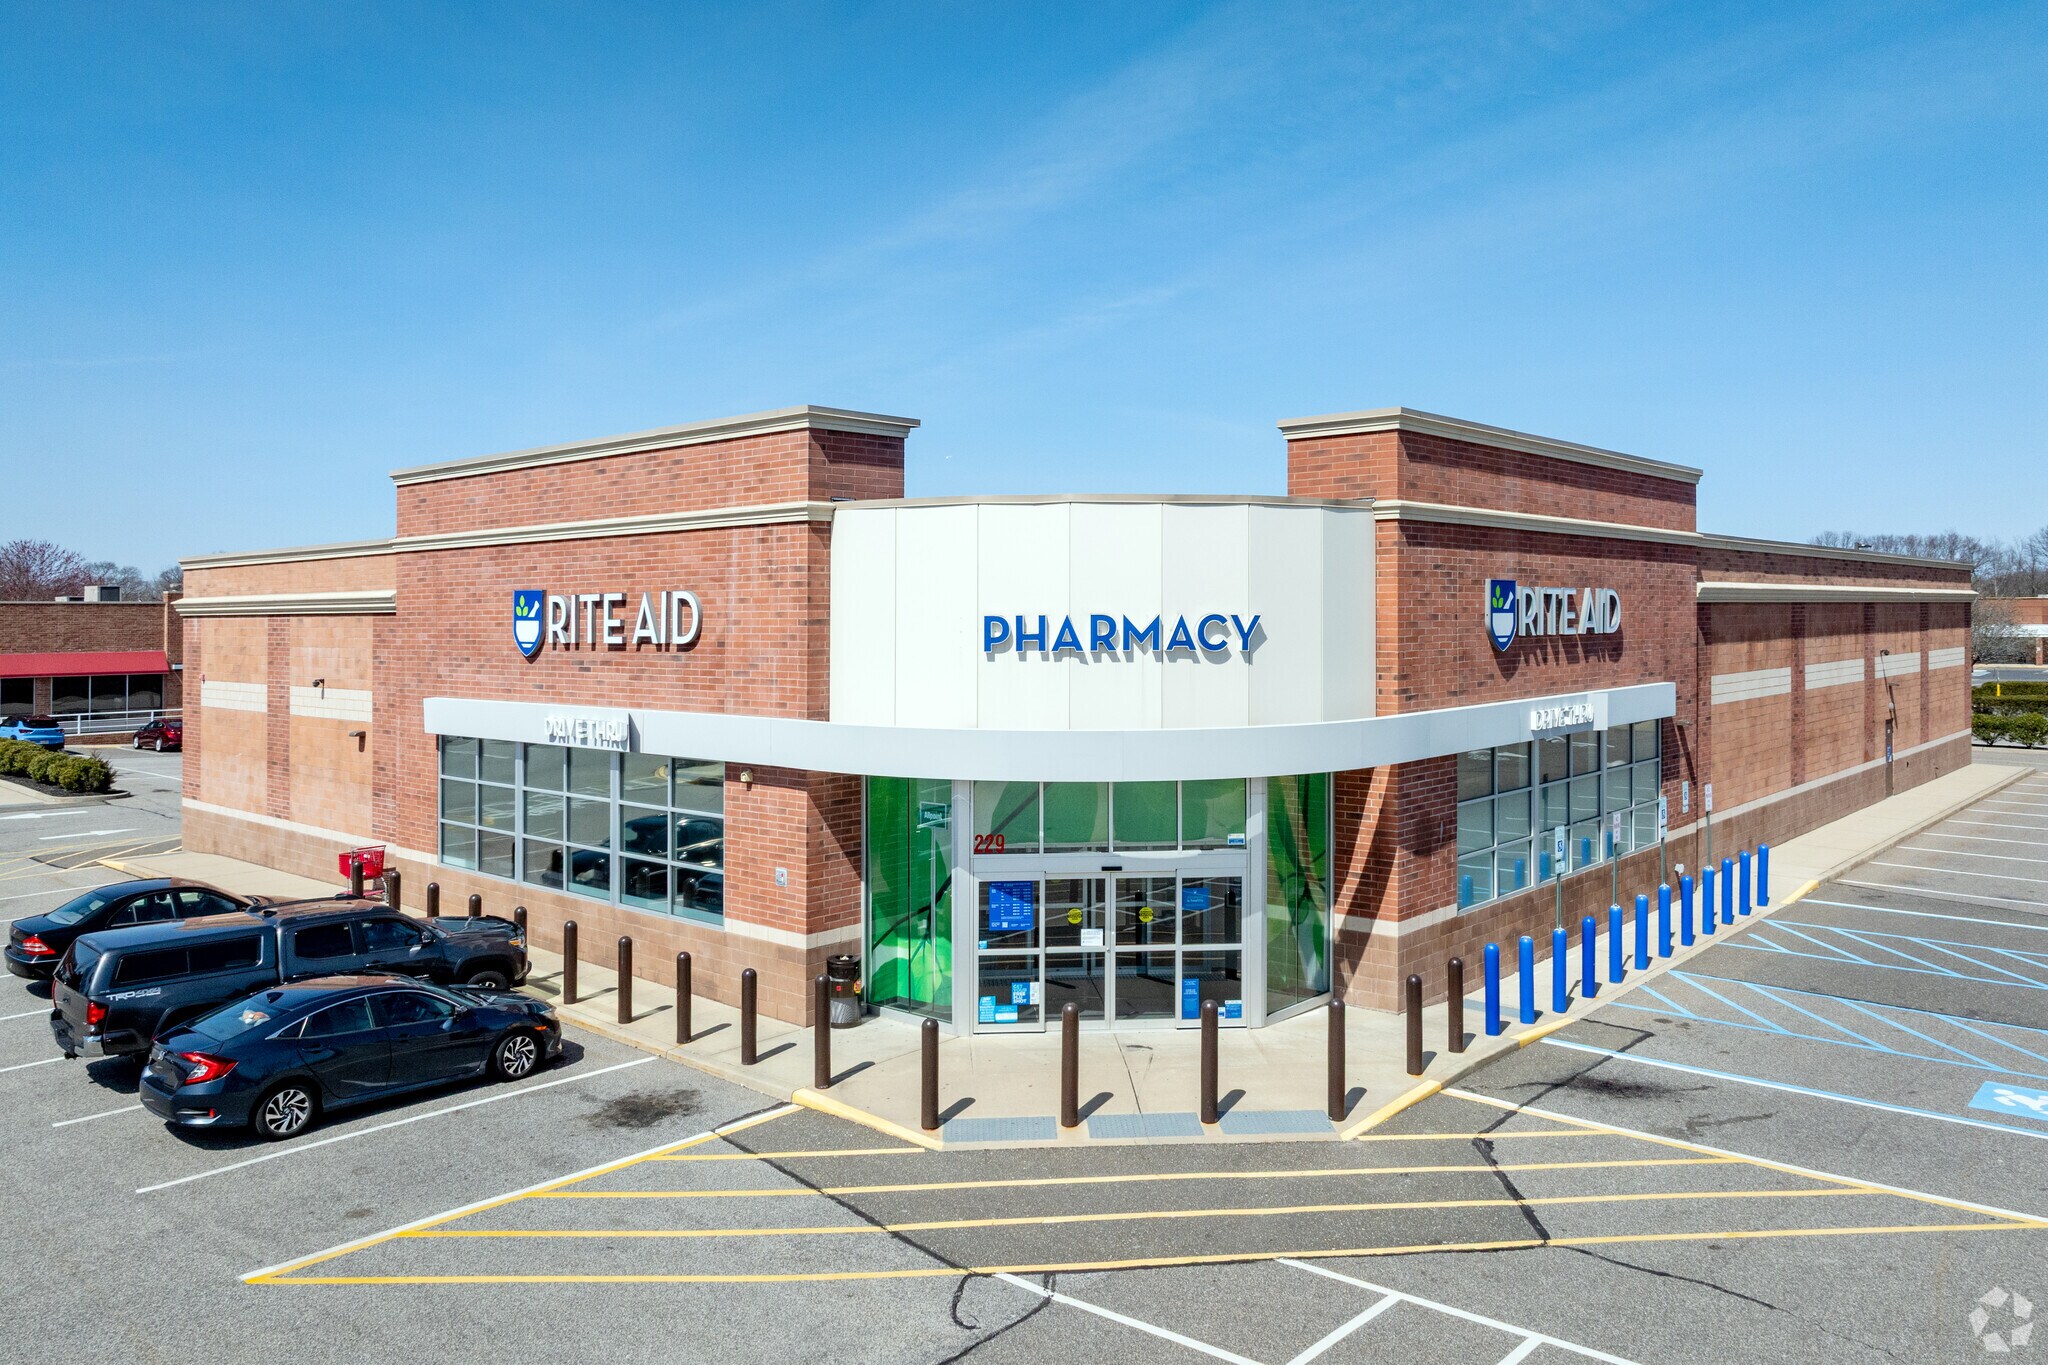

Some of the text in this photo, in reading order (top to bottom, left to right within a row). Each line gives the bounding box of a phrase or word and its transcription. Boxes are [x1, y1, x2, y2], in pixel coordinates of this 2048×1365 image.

[548, 590, 702, 645] RITE AID
[1519, 586, 1622, 637] RITE AID
[983, 613, 1262, 653] PHARMACY
[974, 833, 1005, 854] 229
[105, 991, 135, 1001] TRD
